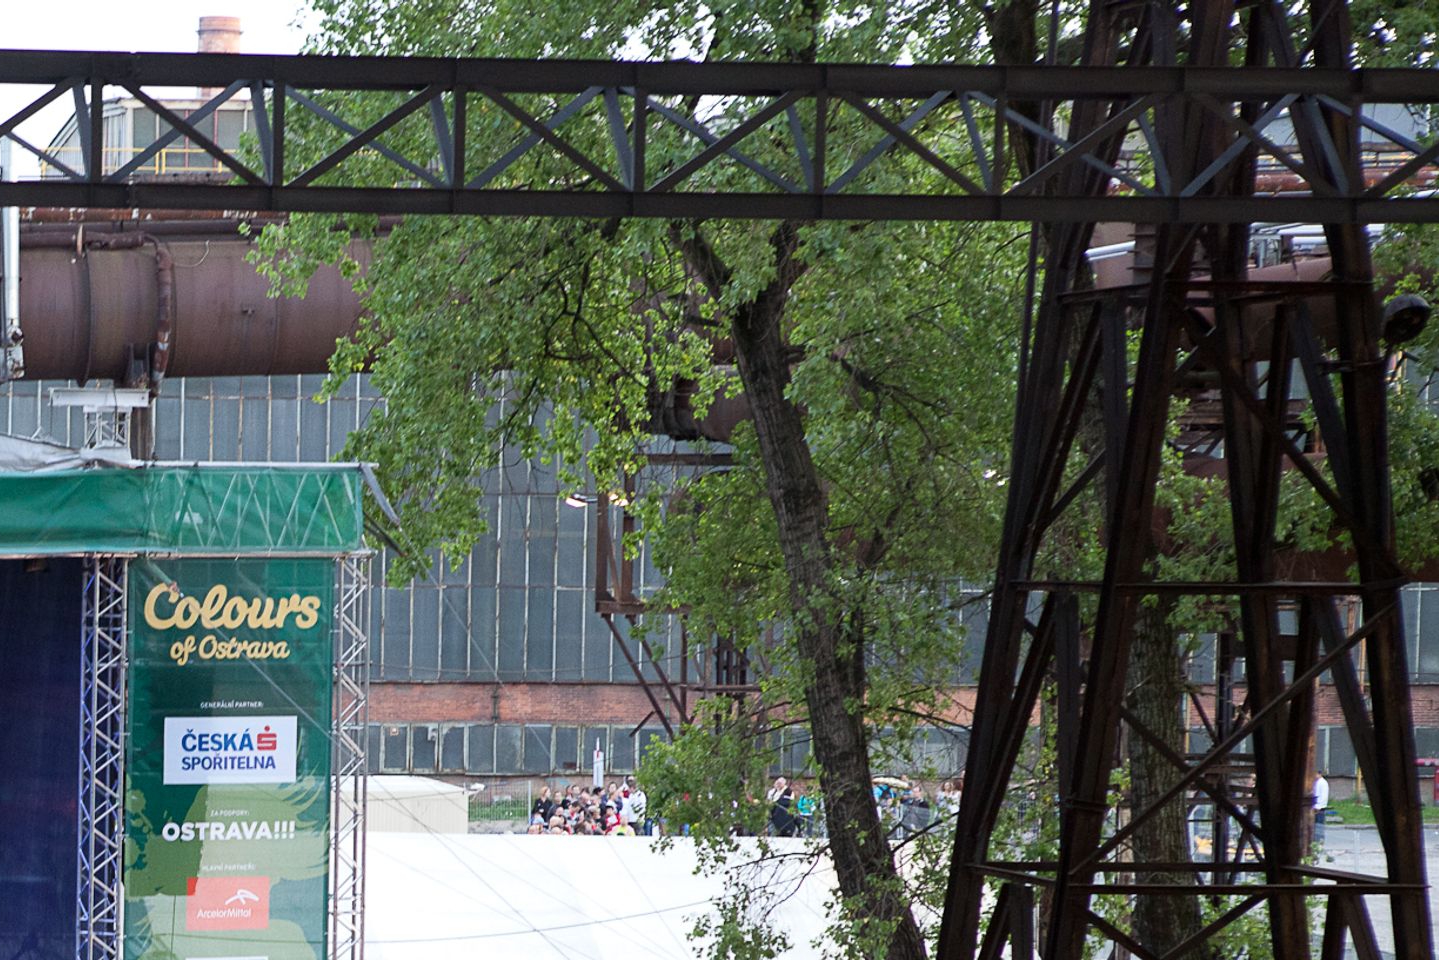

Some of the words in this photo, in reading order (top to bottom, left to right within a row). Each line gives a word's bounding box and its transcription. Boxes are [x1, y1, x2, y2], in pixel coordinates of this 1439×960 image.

[144, 582, 321, 630] Colours
[170, 634, 197, 666] of
[198, 634, 291, 660] Ostrava
[181, 728, 254, 752] ČESKÁ
[181, 753, 276, 771] SPOŘITELNA
[161, 820, 296, 841] OSTRAVA!!!
[197, 907, 251, 919] ArcelorMittal
